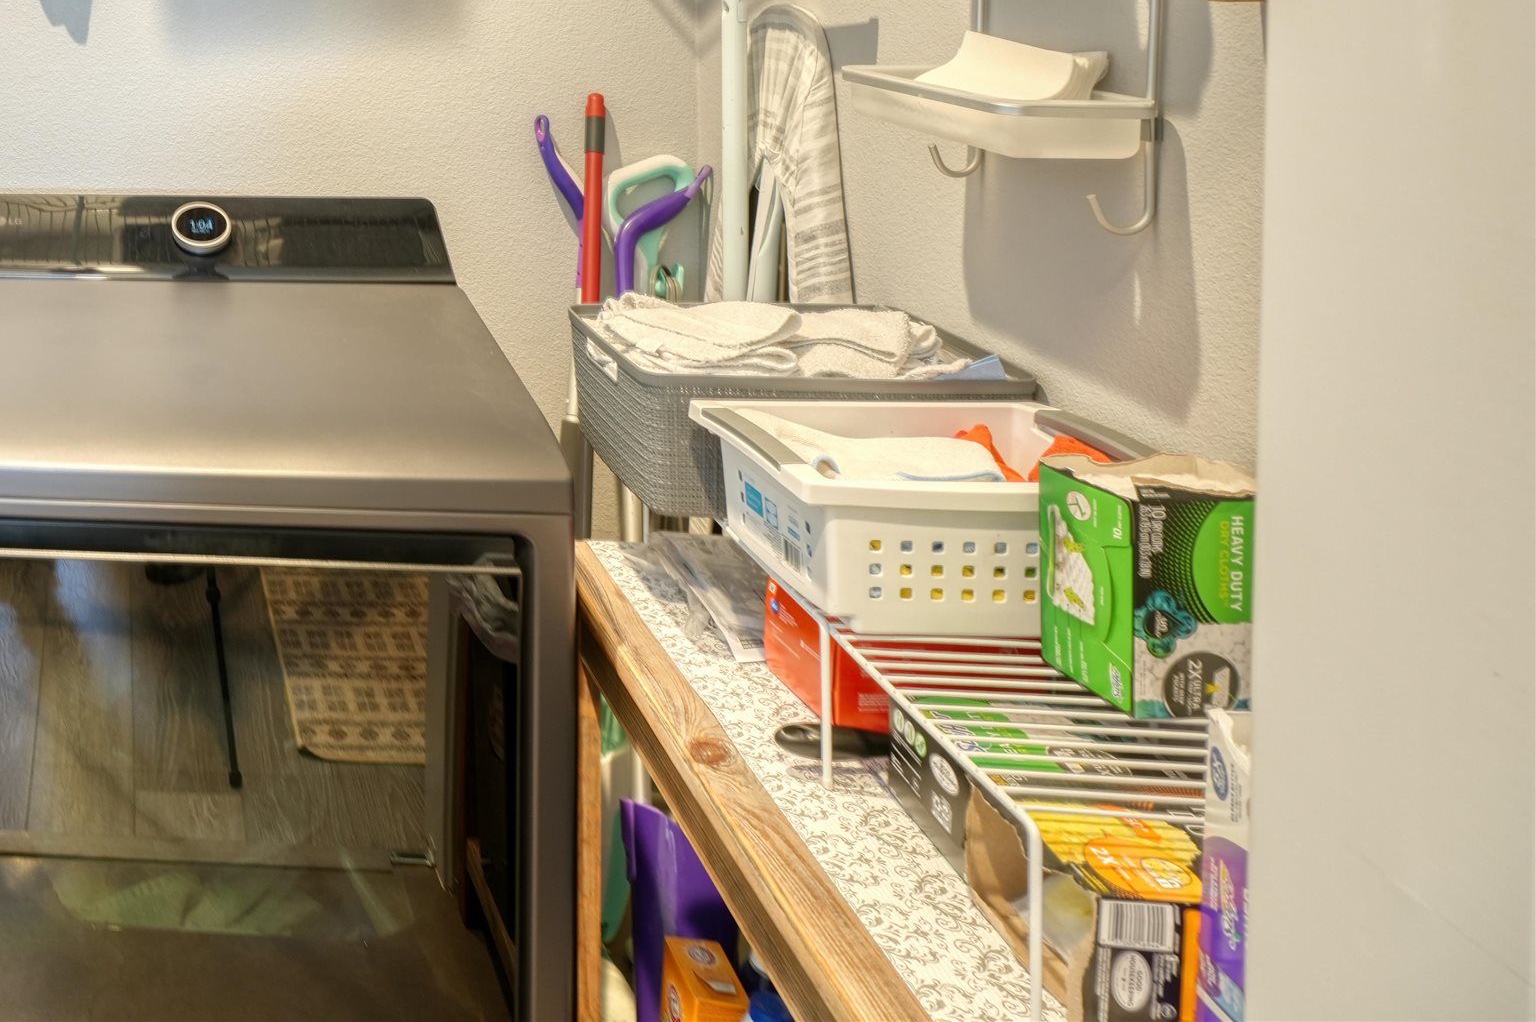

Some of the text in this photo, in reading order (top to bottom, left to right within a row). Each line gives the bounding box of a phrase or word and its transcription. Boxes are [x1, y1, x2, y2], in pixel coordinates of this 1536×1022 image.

[1151, 505, 1167, 519] 10
[1219, 520, 1230, 546] DRY
[1230, 516, 1244, 612] HEAVY DUTY
[1186, 658, 1203, 680] 2X
[1088, 845, 1119, 867] 2X
[1126, 954, 1137, 1007] HOUSEKEEPING
[1136, 969, 1144, 992] GOOD
